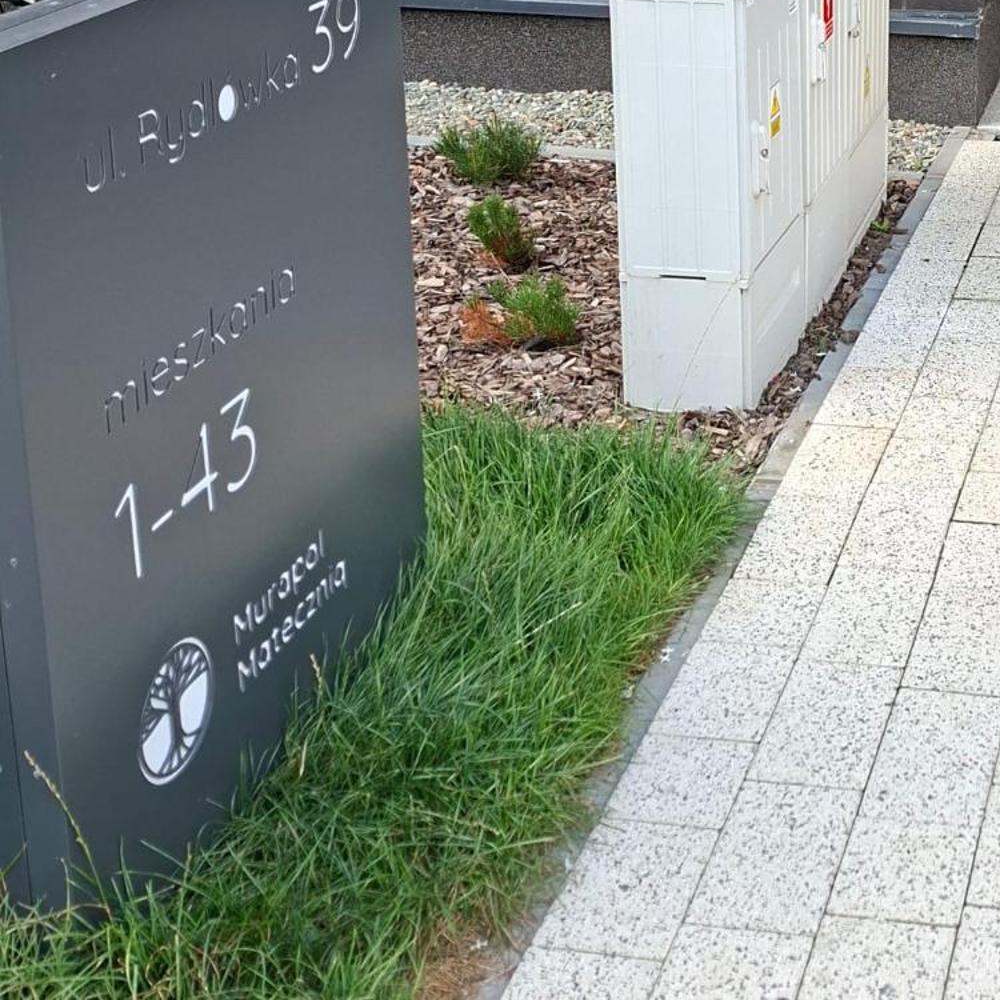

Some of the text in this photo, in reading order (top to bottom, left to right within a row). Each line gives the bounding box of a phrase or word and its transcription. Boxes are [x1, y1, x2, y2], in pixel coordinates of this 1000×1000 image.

[82, 126, 126, 192] ul.
[138, 50, 298, 166] Rydlówka
[104, 265, 296, 435] mieszkania
[115, 387, 256, 578] 1-43
[233, 528, 325, 645] Murapol
[237, 559, 347, 694] Matecznia
